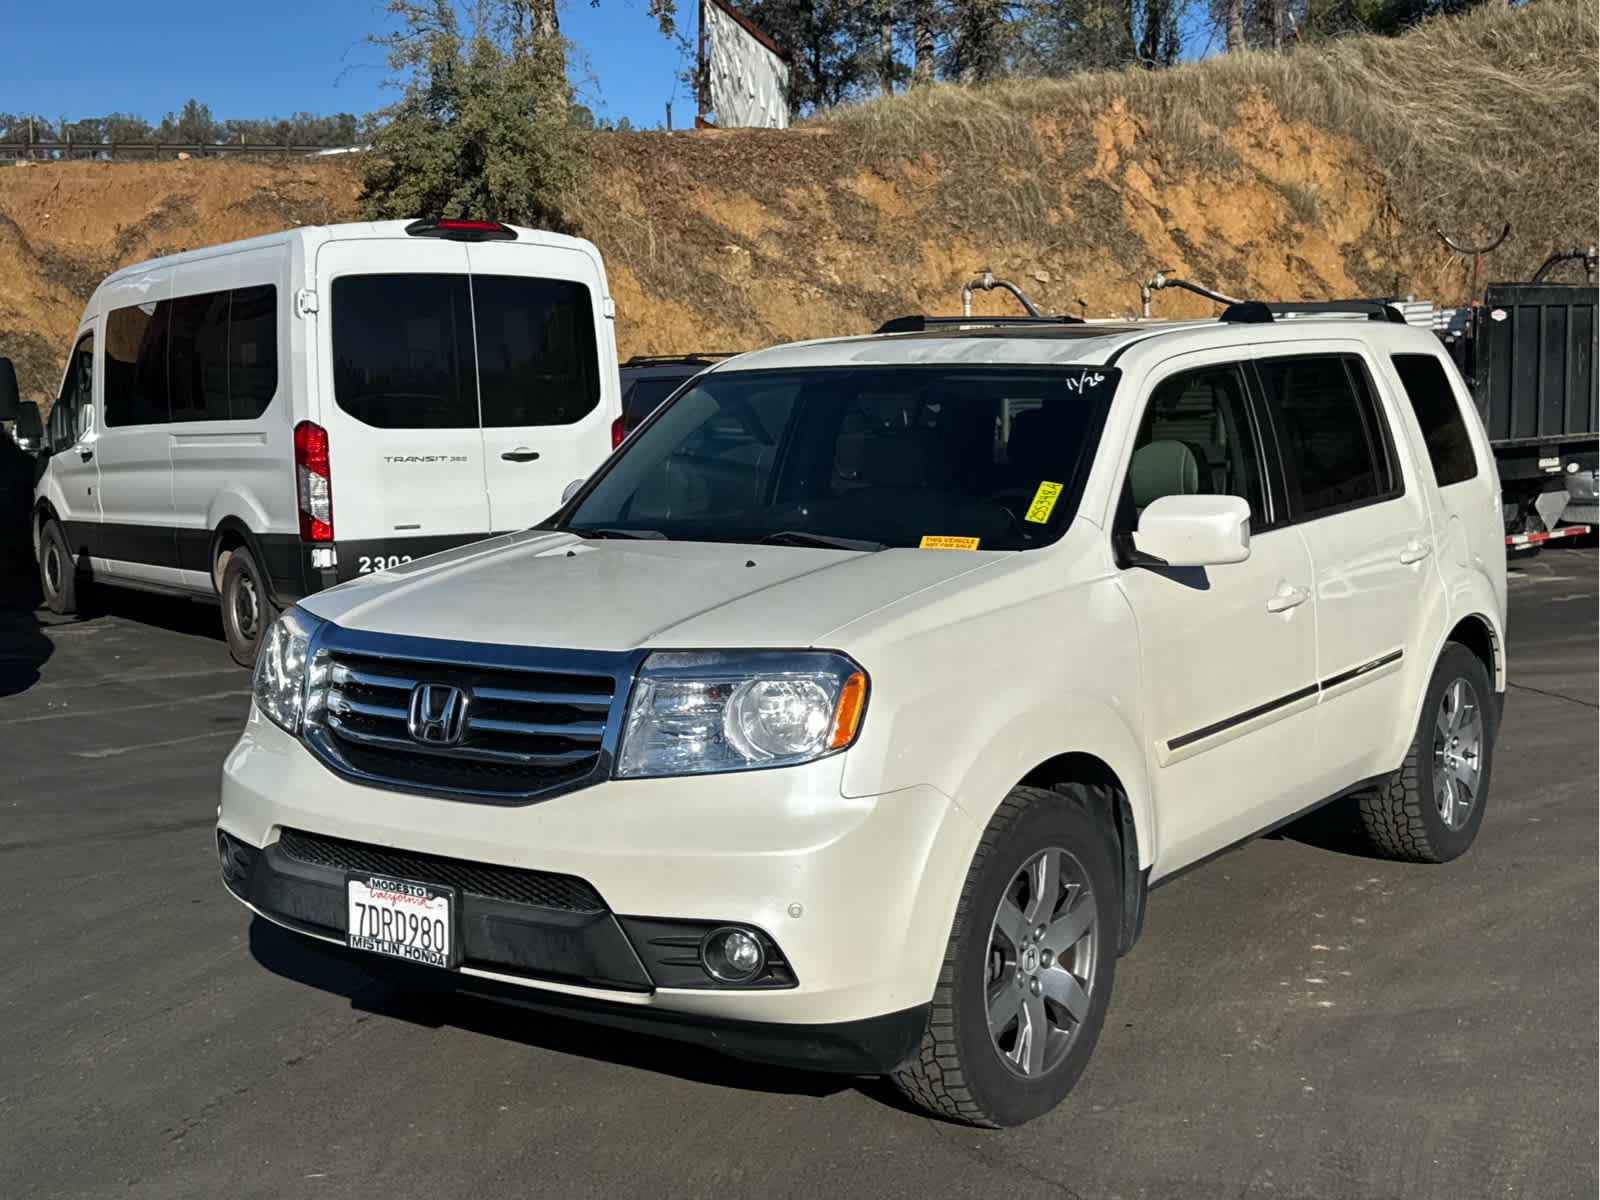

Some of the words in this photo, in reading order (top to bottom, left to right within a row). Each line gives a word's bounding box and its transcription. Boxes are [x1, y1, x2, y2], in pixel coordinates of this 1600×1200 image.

[1065, 368, 1105, 395] 11/26
[371, 878, 425, 897] MODESTO
[355, 902, 445, 953] 7DRD980
[351, 936, 401, 955] MISTLIN
[404, 945, 445, 967] HONDA
